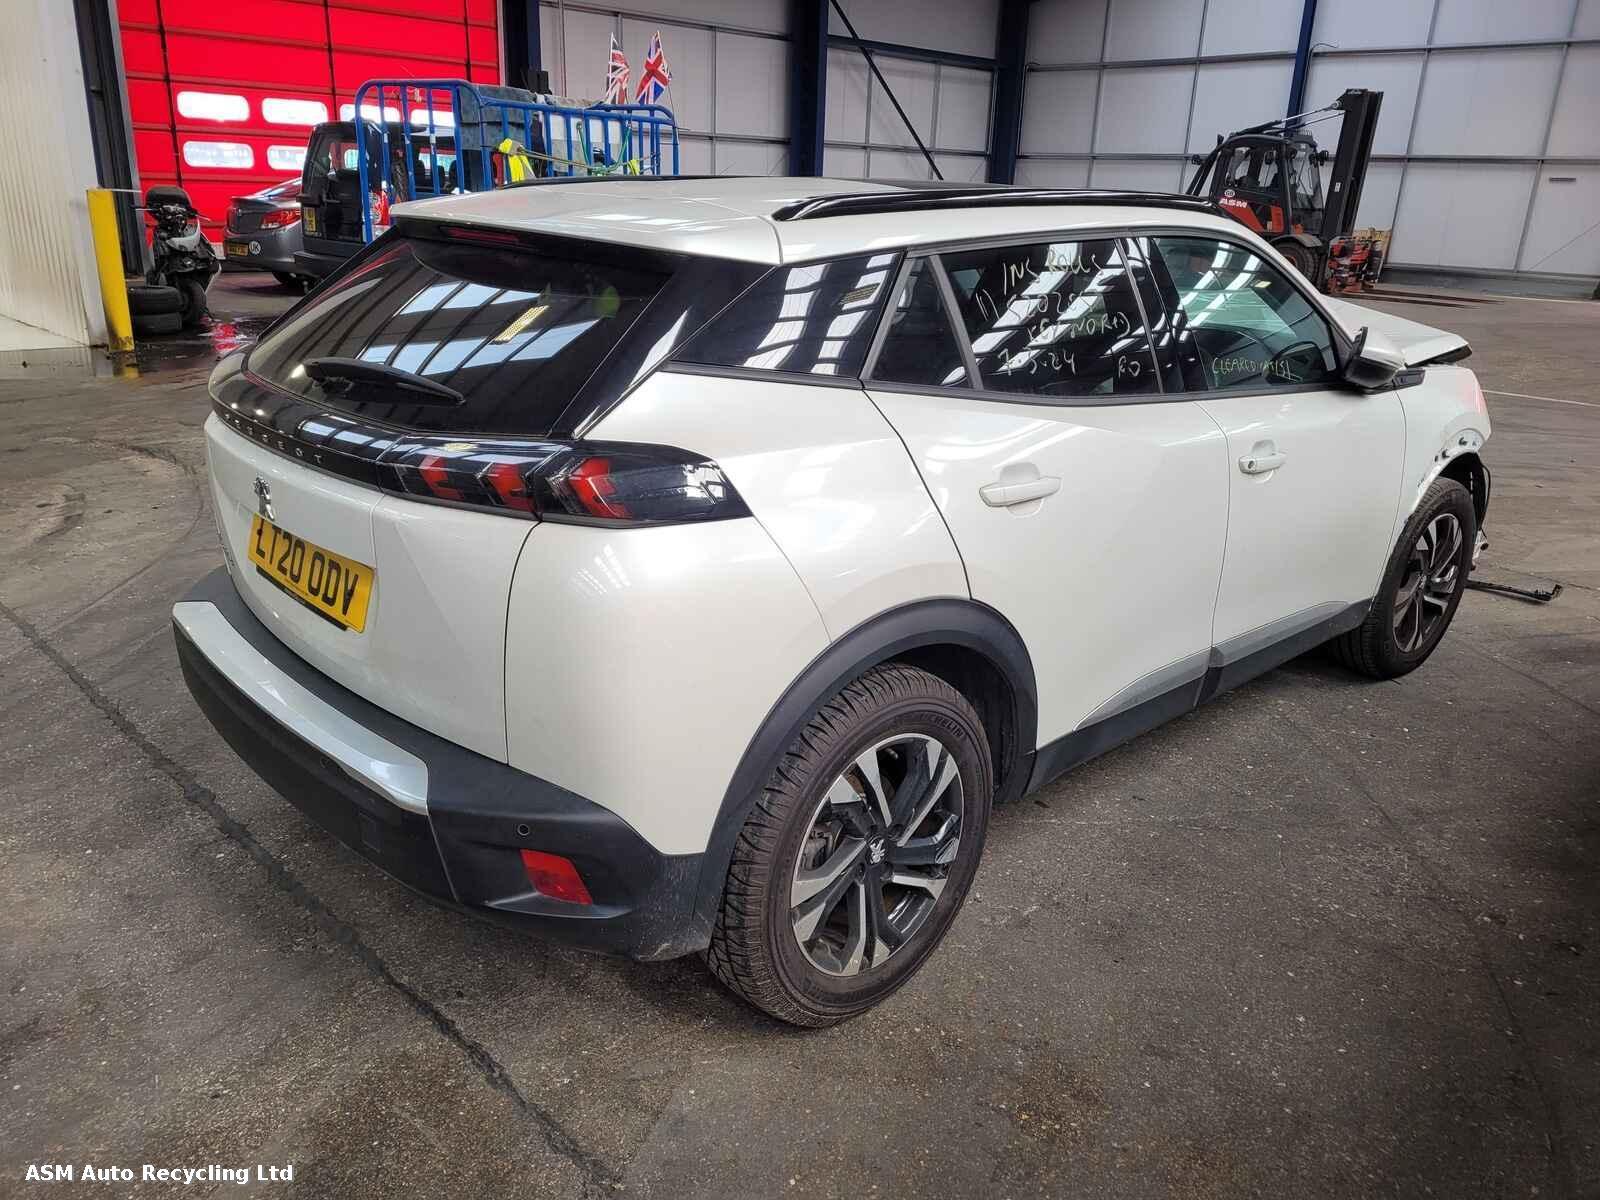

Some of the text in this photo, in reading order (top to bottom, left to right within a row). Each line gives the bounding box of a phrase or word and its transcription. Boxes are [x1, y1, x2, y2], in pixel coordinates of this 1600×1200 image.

[1219, 198, 1247, 208] ASM
[255, 518, 306, 585] LT20
[307, 550, 359, 617] ODV
